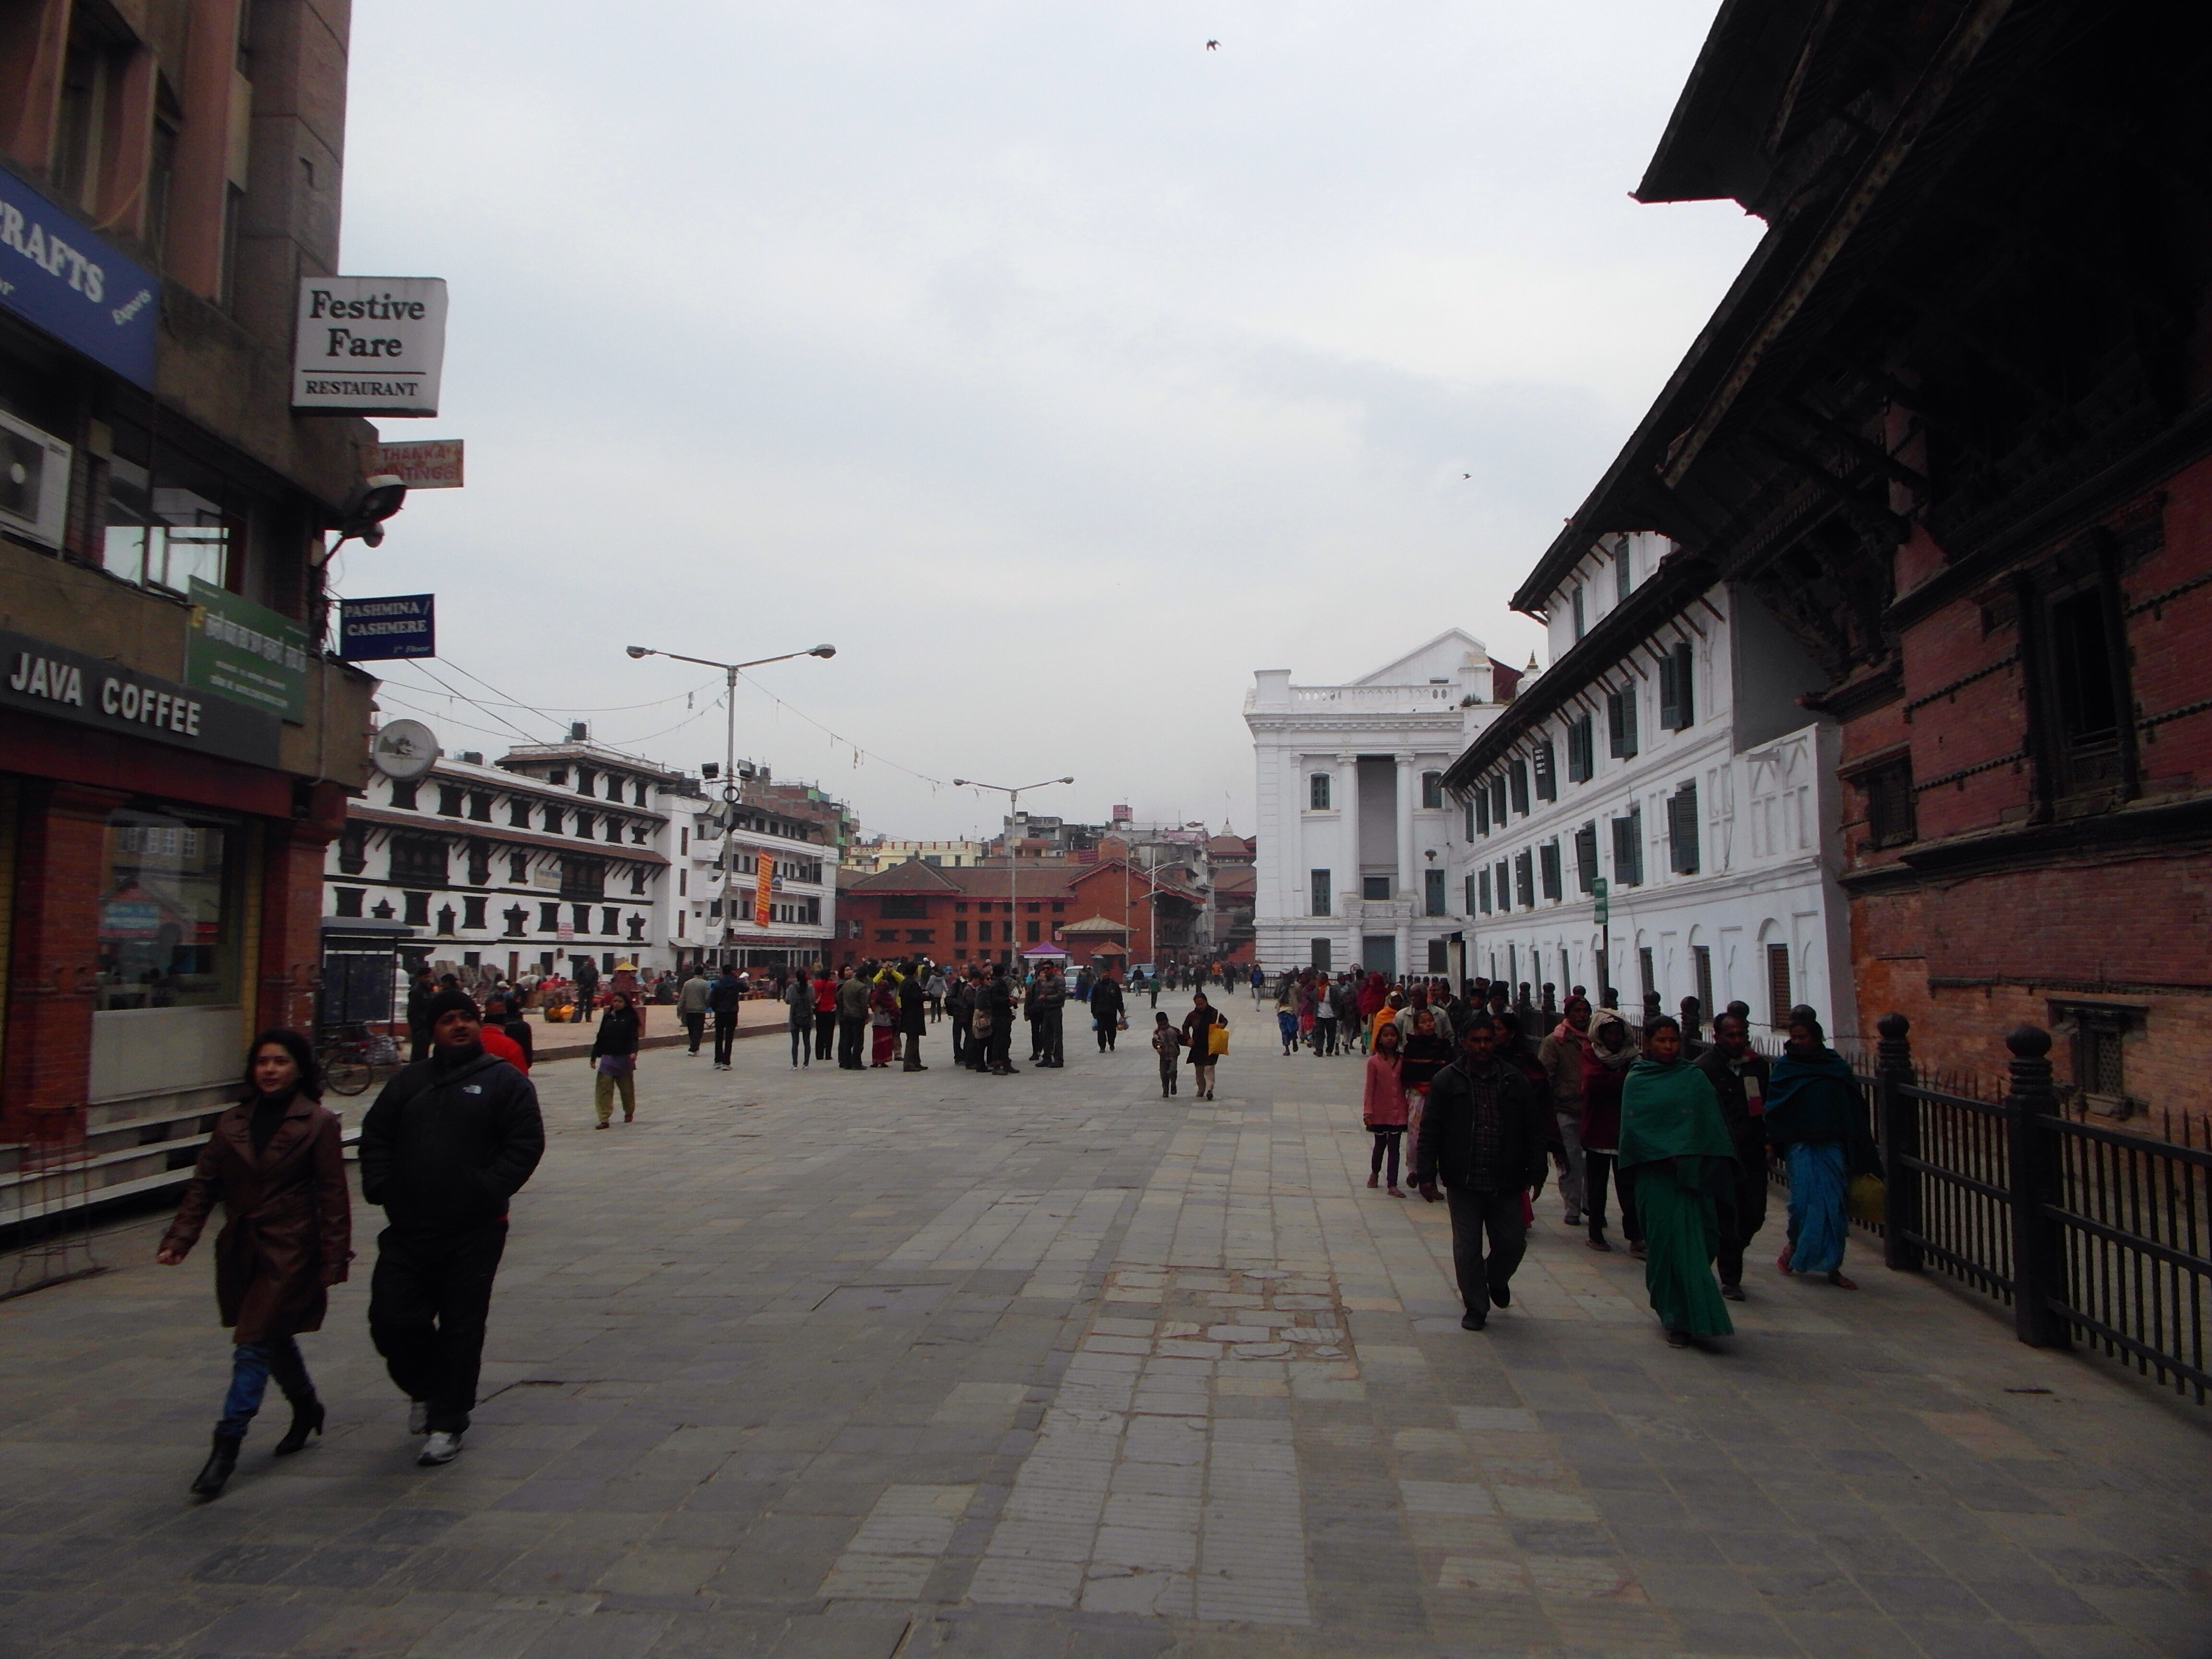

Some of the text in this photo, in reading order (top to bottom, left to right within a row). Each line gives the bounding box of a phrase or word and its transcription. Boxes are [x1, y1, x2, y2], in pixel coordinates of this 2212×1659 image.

[0, 199, 105, 303] RAFTS
[309, 290, 425, 320] Festive
[326, 328, 403, 357] Fare
[306, 380, 419, 396] RESTAURANT
[343, 601, 420, 618] PASHMINA
[347, 619, 427, 636] CASHMERE
[11, 651, 84, 707] JAVA
[102, 677, 202, 736] COFFEE
